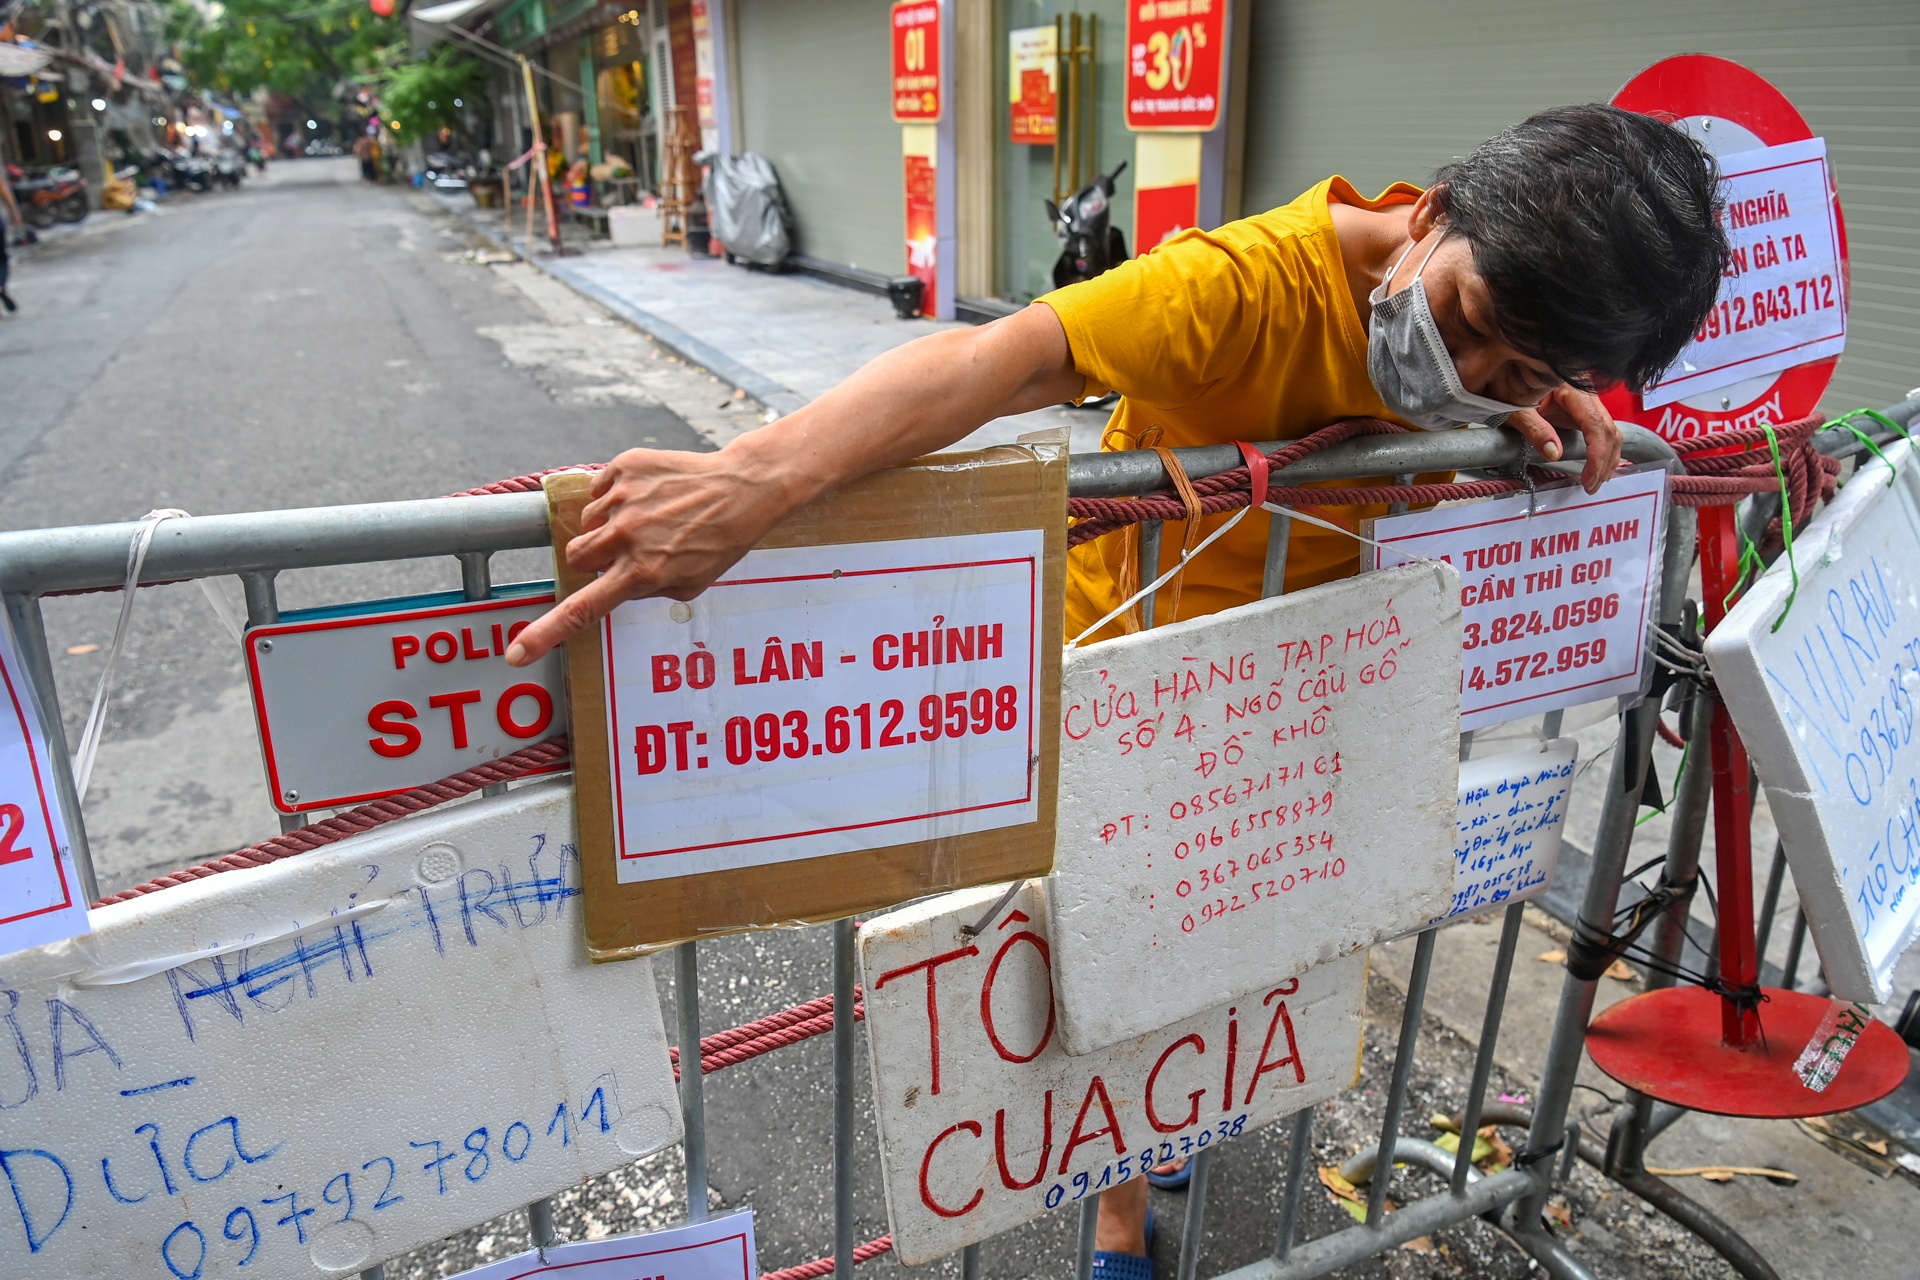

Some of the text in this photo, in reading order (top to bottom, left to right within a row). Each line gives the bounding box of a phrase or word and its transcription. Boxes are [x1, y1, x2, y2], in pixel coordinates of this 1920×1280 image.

[905, 27, 926, 71] 01
[1729, 189, 1790, 229] NGHĨA
[1753, 235, 1780, 270] GÀ
[1782, 234, 1807, 262] TA
[1656, 407, 1700, 441] NO
[1463, 541, 1521, 572] TƯƠI
[1531, 531, 1580, 560] KIM
[1587, 519, 1639, 548] ANH
[1461, 557, 1612, 607] CẦN THÌ GỌI
[651, 641, 716, 693] BÒ
[733, 637, 824, 686] LÂN
[873, 615, 1003, 671] CHỈNH
[1154, 652, 1254, 706] HÀNG
[1278, 634, 1333, 673] TẠP
[634, 686, 1018, 775] ĐT: 093.612.9598
[1273, 705, 1333, 747] KHÔ
[875, 908, 1056, 1096] TÔ
[1045, 1113, 1248, 1210] 0915827038
